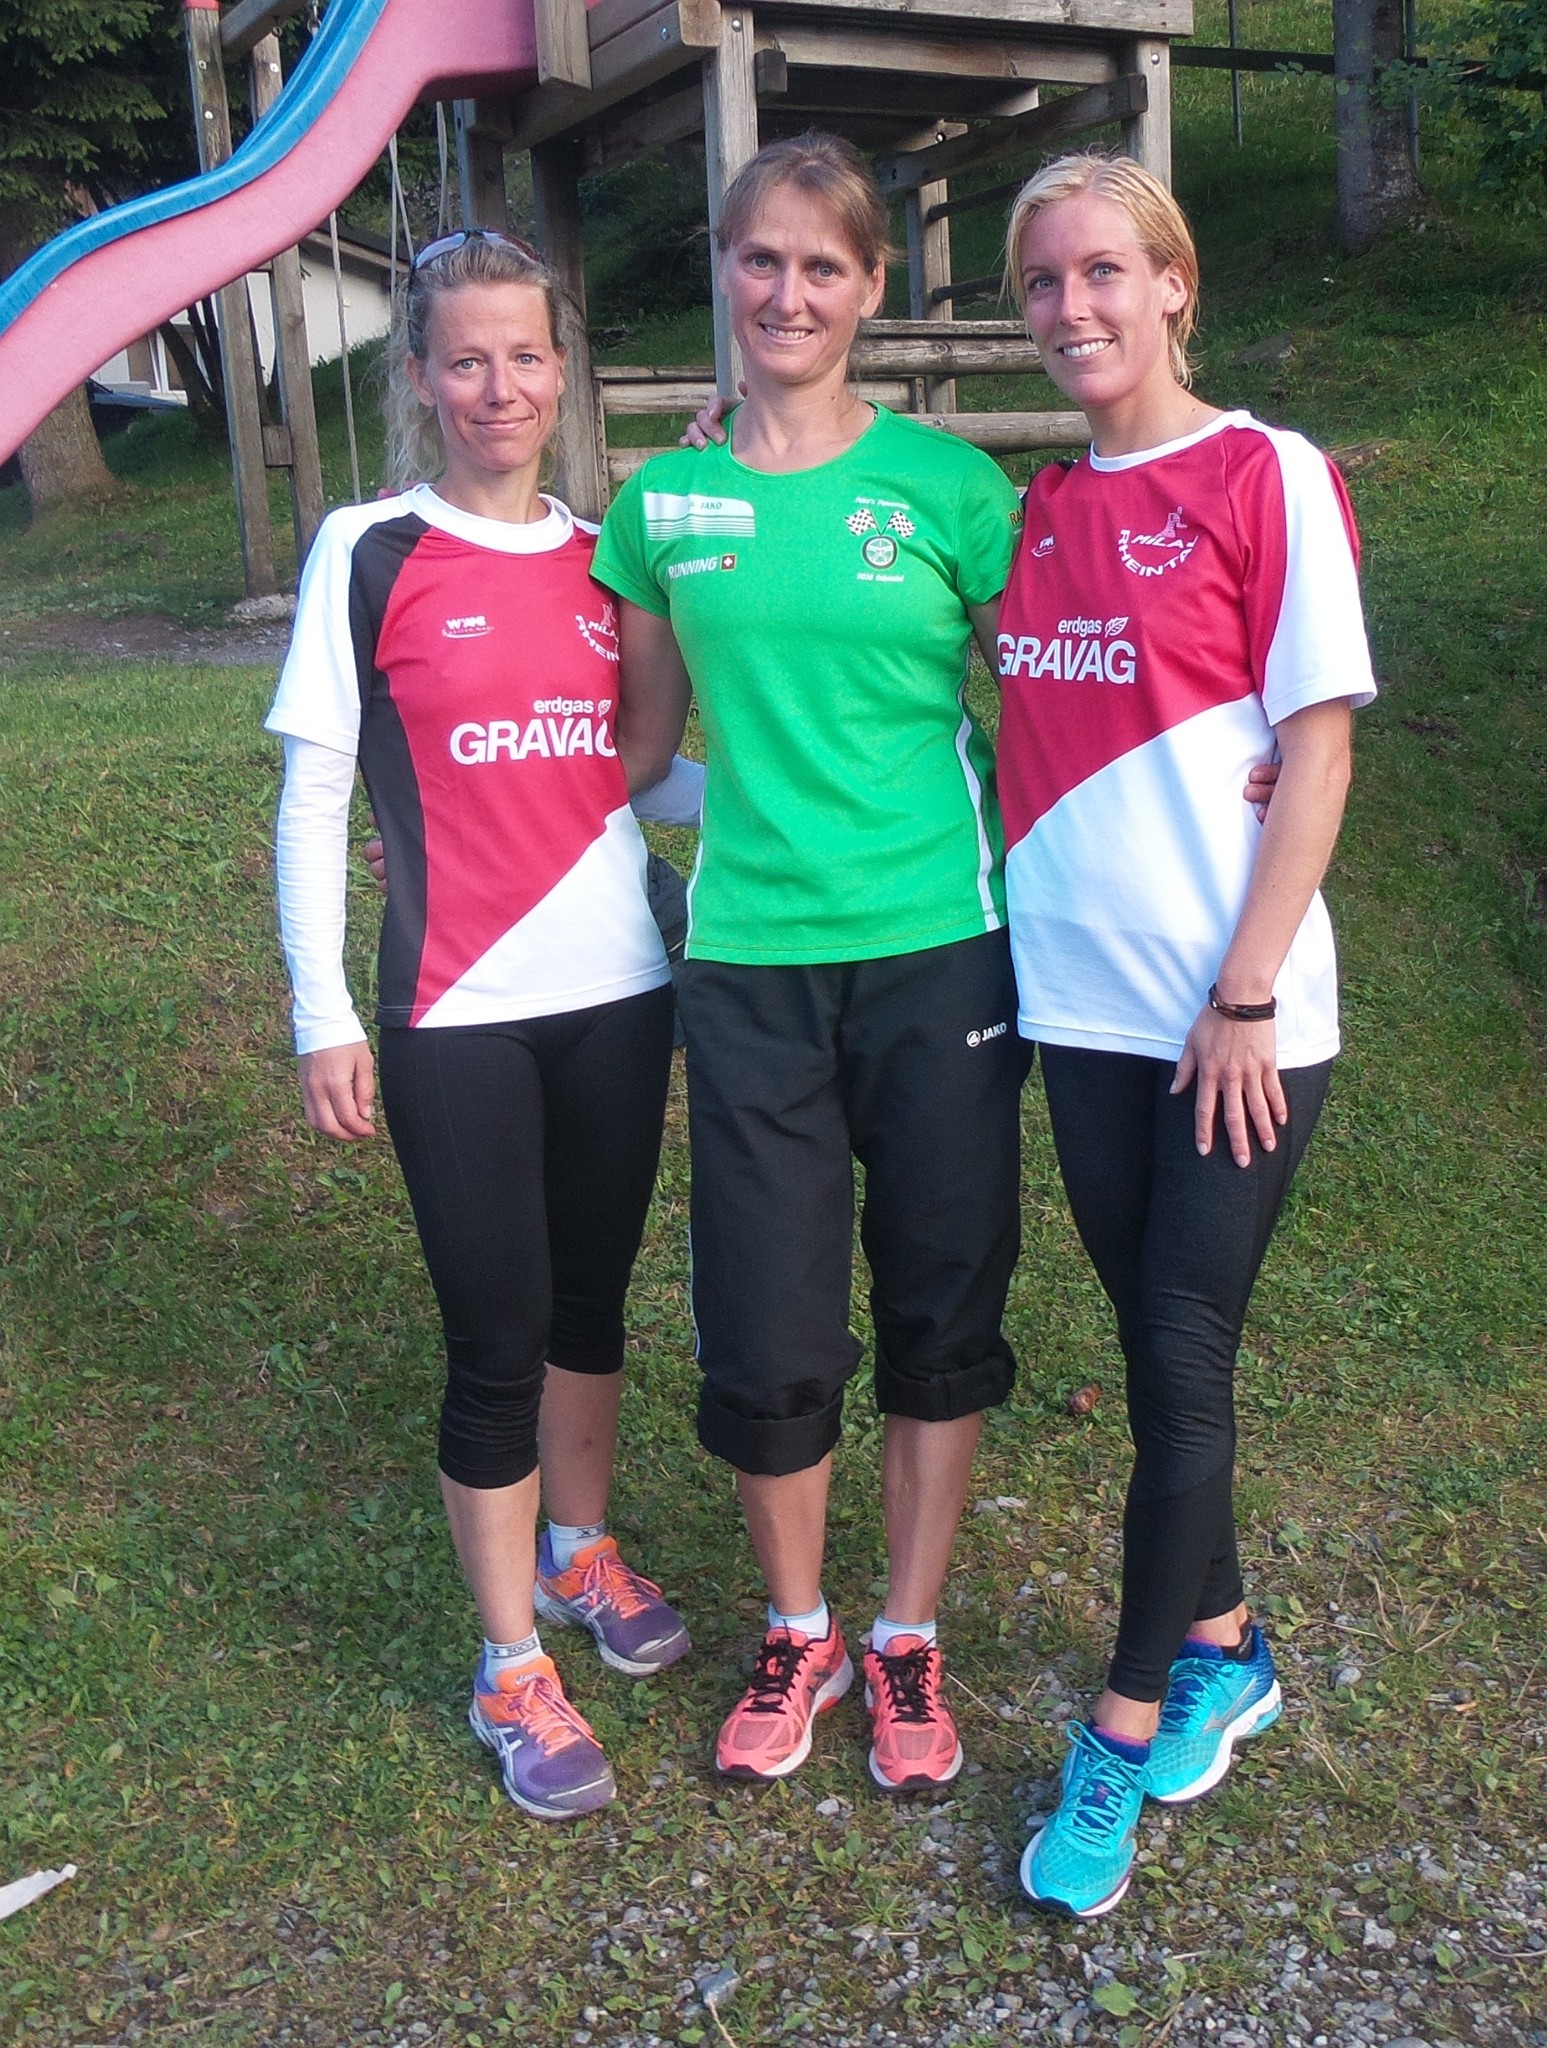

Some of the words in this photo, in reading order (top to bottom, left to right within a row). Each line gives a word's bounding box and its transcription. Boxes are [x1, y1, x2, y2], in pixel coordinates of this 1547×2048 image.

[700, 502, 722, 510] JAKO
[1131, 534, 1184, 549] MILA
[1118, 530, 1198, 577] RHEINTAL
[668, 556, 719, 580] RUNNING
[575, 614, 620, 661] RHEIN
[1057, 616, 1103, 638] erdgas
[997, 633, 1136, 684] GRAVAG
[533, 696, 594, 717] erdgas
[982, 1022, 1007, 1041] JAKO
